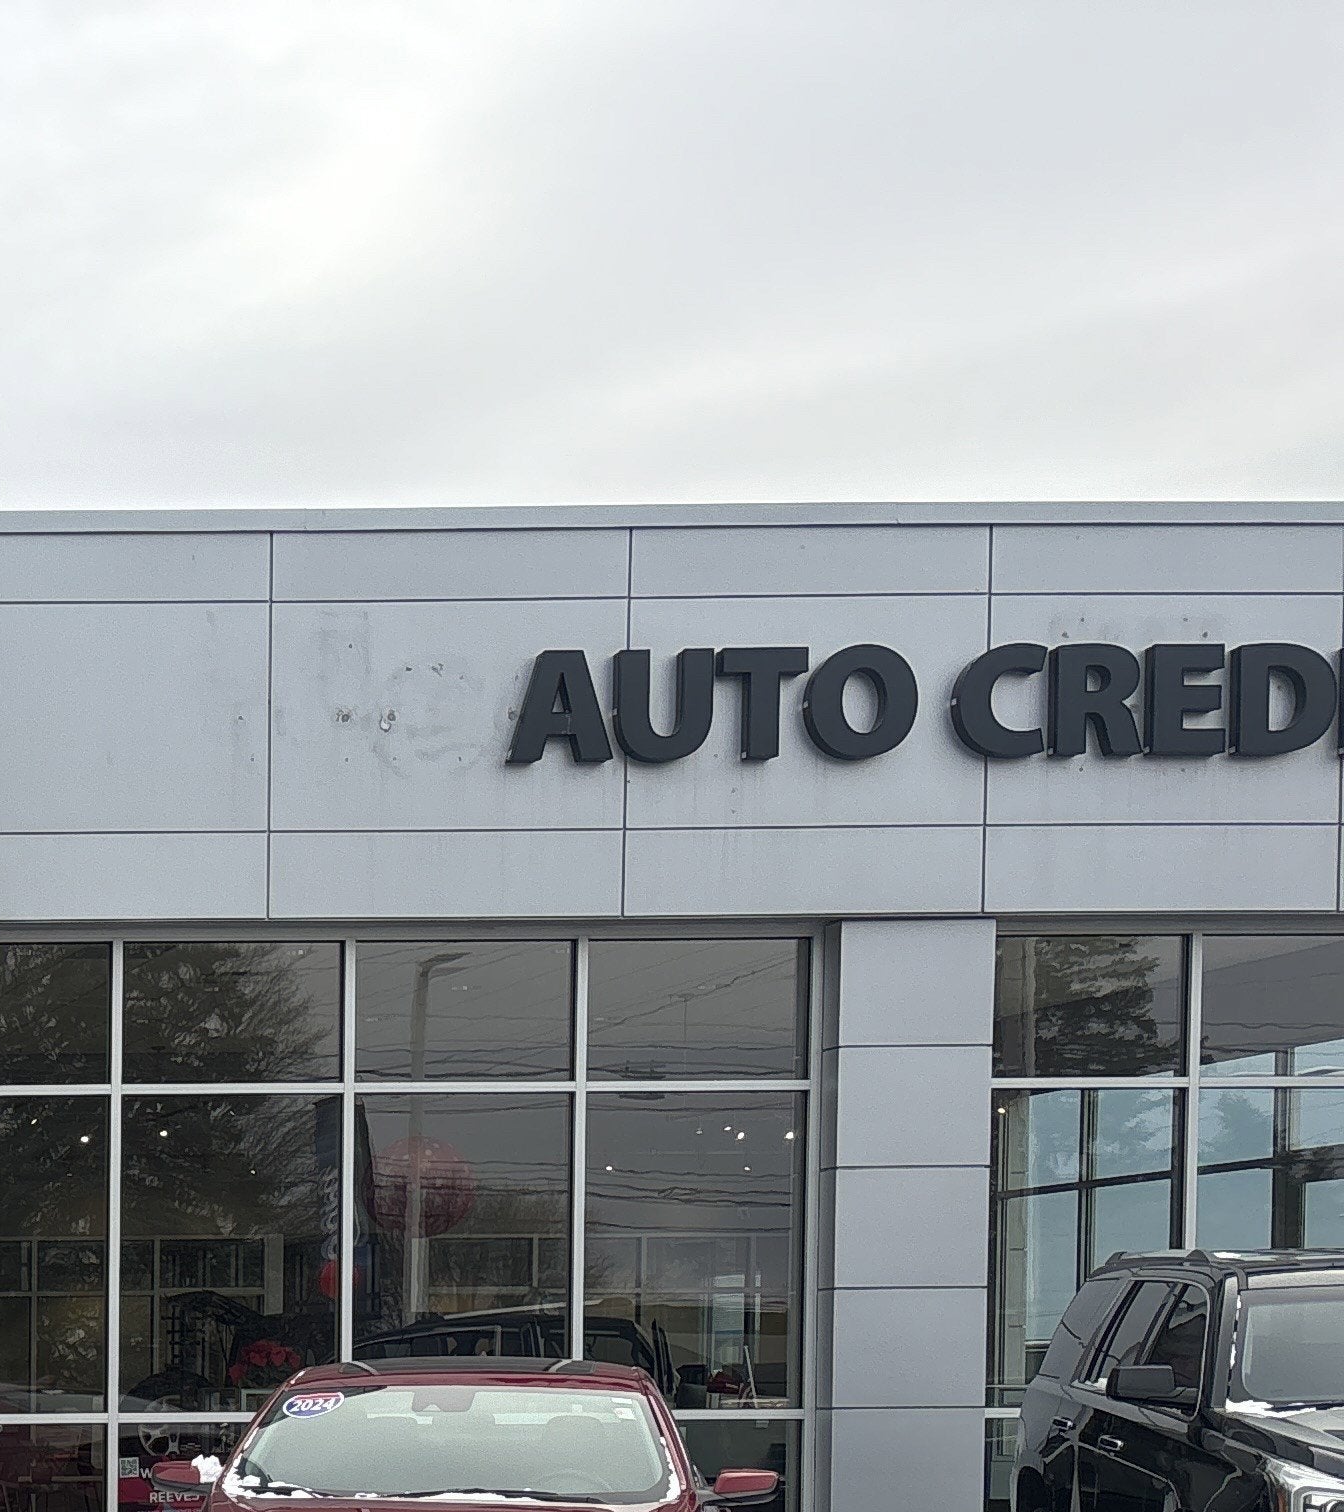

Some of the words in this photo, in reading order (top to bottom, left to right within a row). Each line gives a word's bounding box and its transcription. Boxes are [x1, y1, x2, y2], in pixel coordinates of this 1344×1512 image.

[505, 643, 919, 765] AUTO
[950, 643, 1344, 758] CRED
[289, 1397, 336, 1413] 2024
